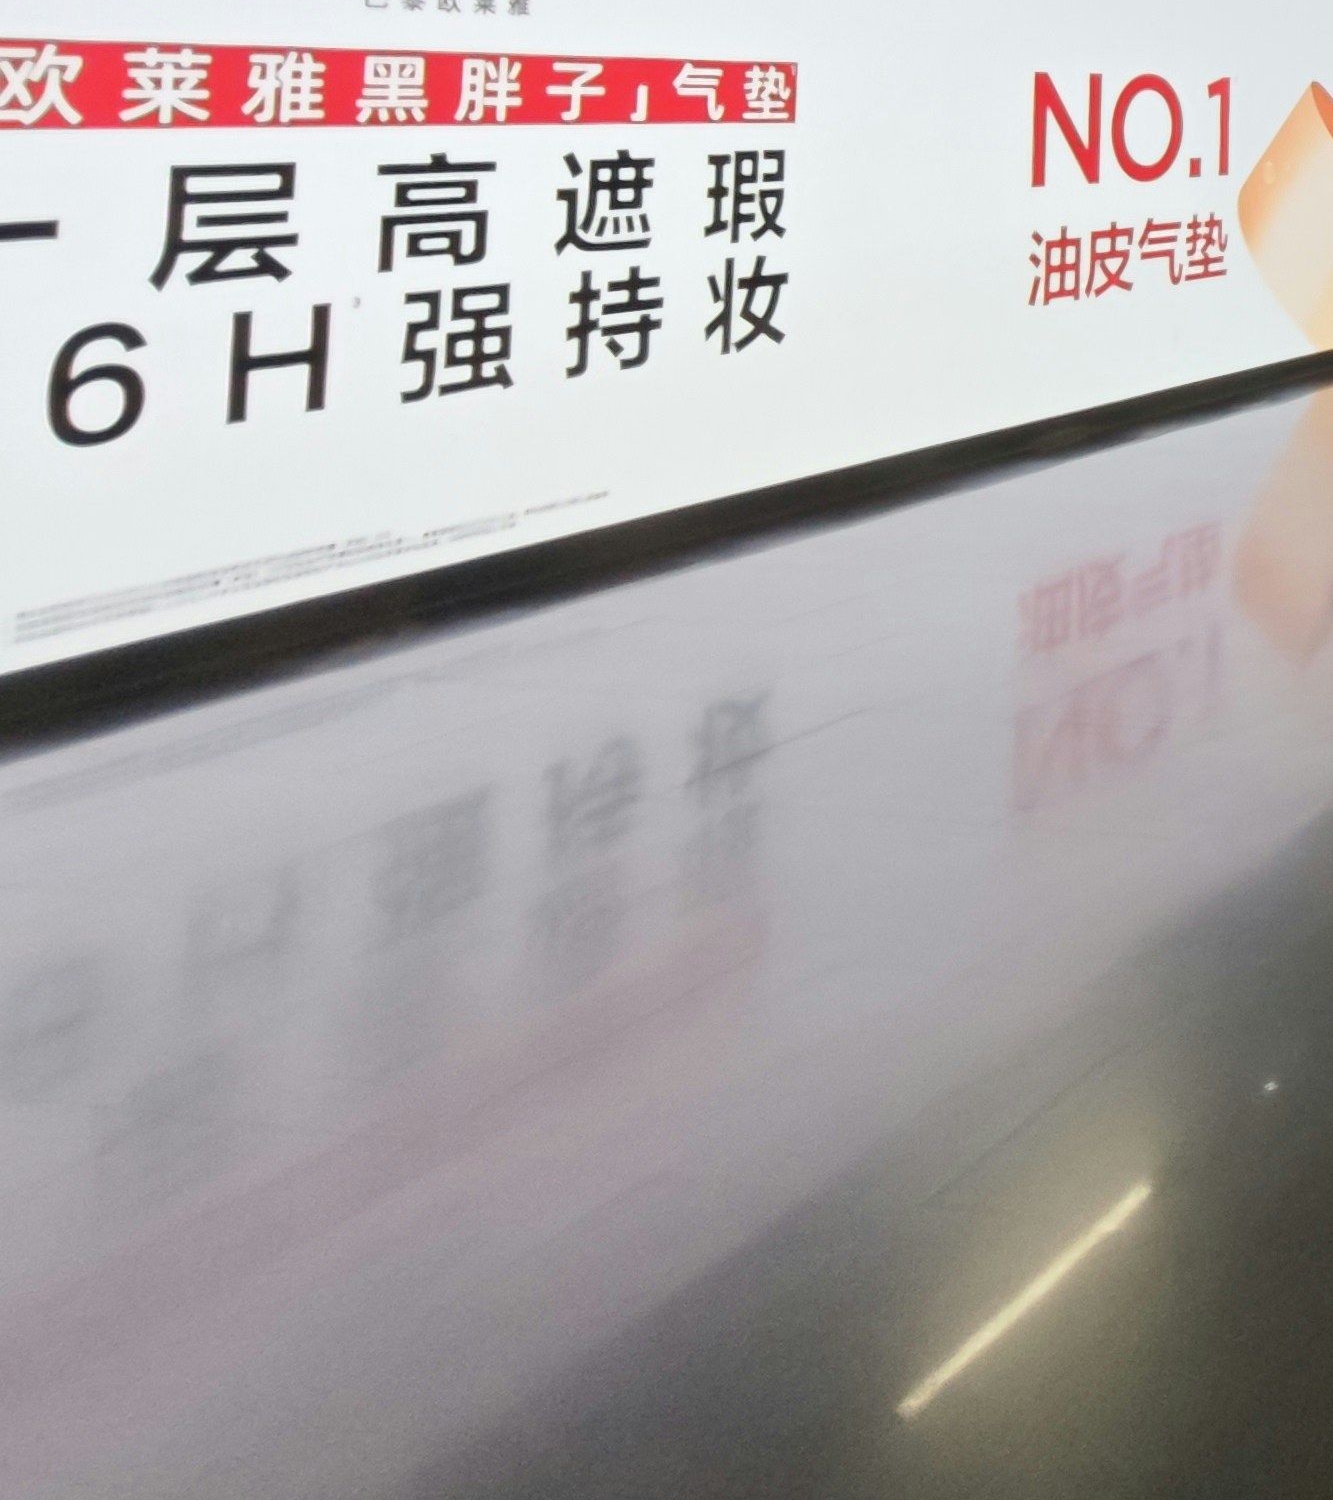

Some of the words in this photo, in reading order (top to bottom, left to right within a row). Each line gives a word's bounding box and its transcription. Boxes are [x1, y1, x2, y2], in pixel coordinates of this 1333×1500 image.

[1032, 72, 1230, 187] NO.1
[1028, 212, 1228, 306] 油皮气垫
